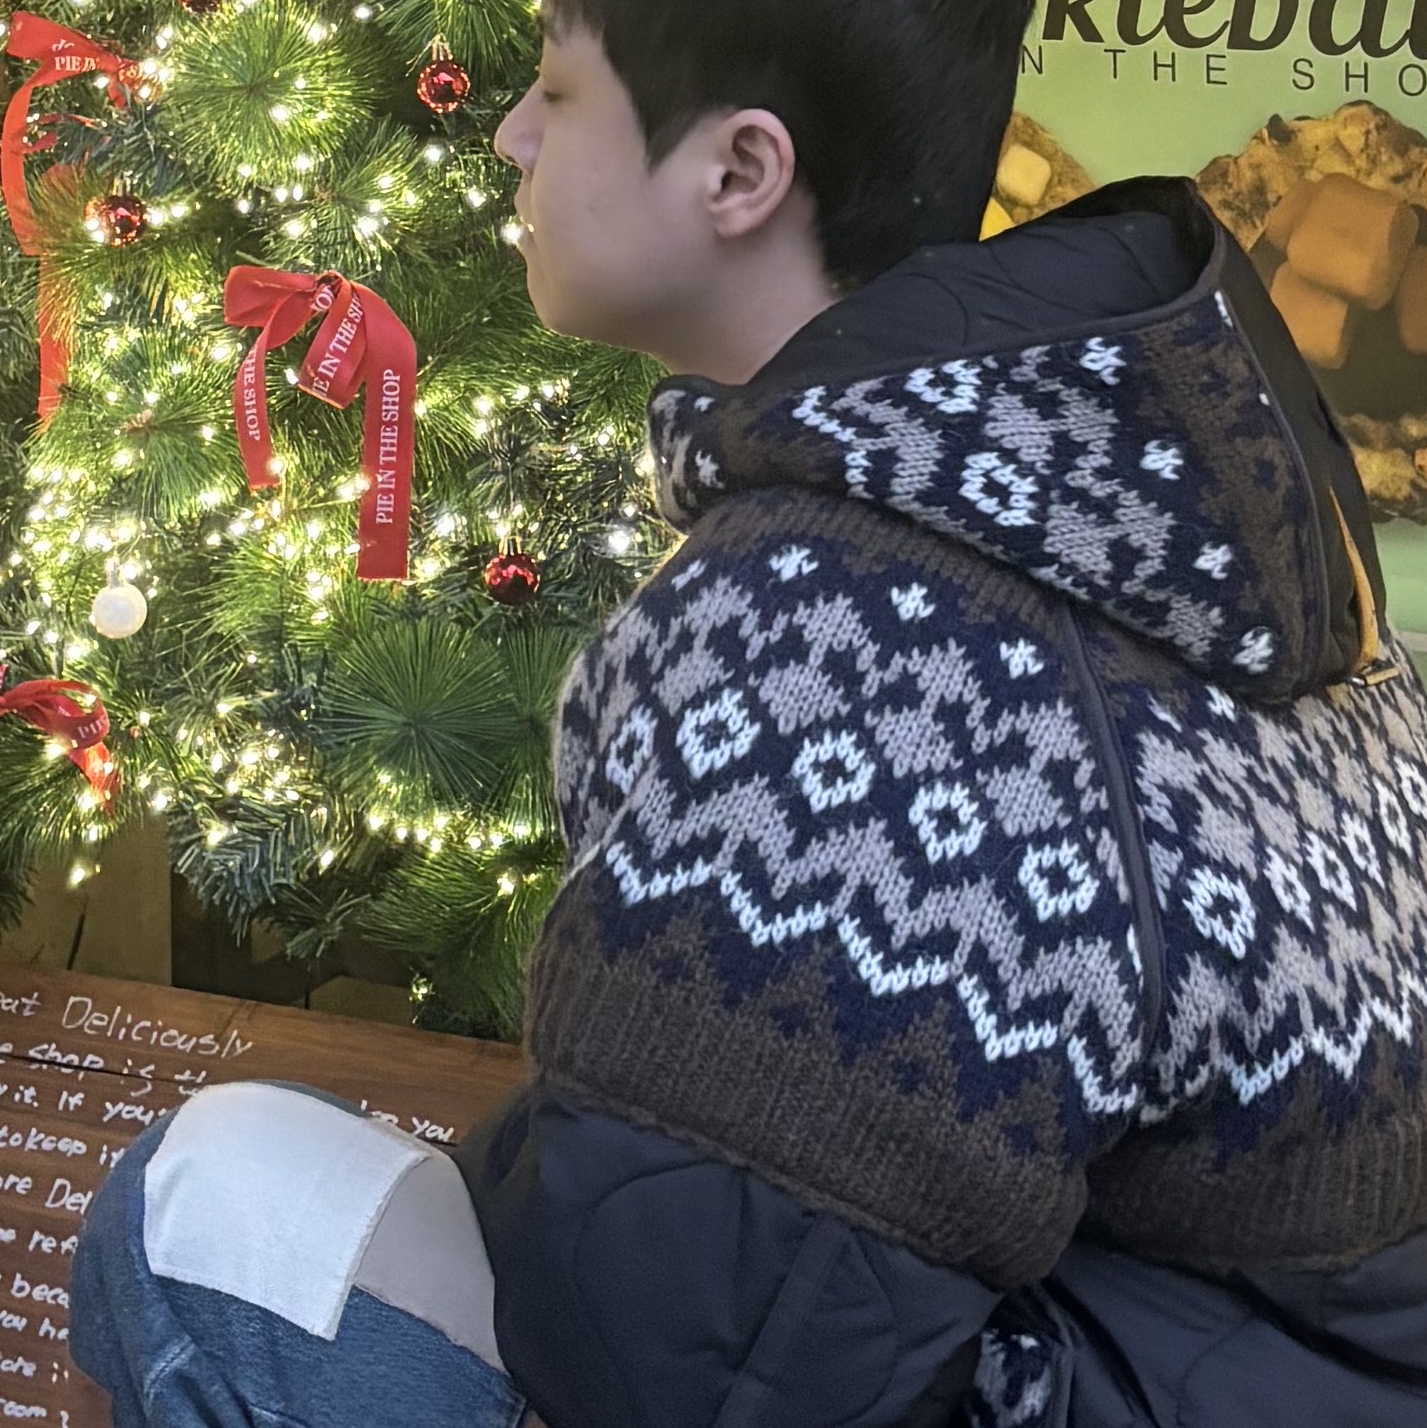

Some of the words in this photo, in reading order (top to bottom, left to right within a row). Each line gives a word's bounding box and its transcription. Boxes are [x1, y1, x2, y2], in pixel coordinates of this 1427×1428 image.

[1104, 48, 1231, 87] THE
[329, 318, 355, 358] THE
[244, 386, 260, 441] SHOP
[383, 369, 400, 424] SHOP
[379, 428, 398, 465] THE
[378, 469, 394, 492] IN
[376, 493, 393, 524] PIE
[61, 995, 253, 1056] Deliciously
